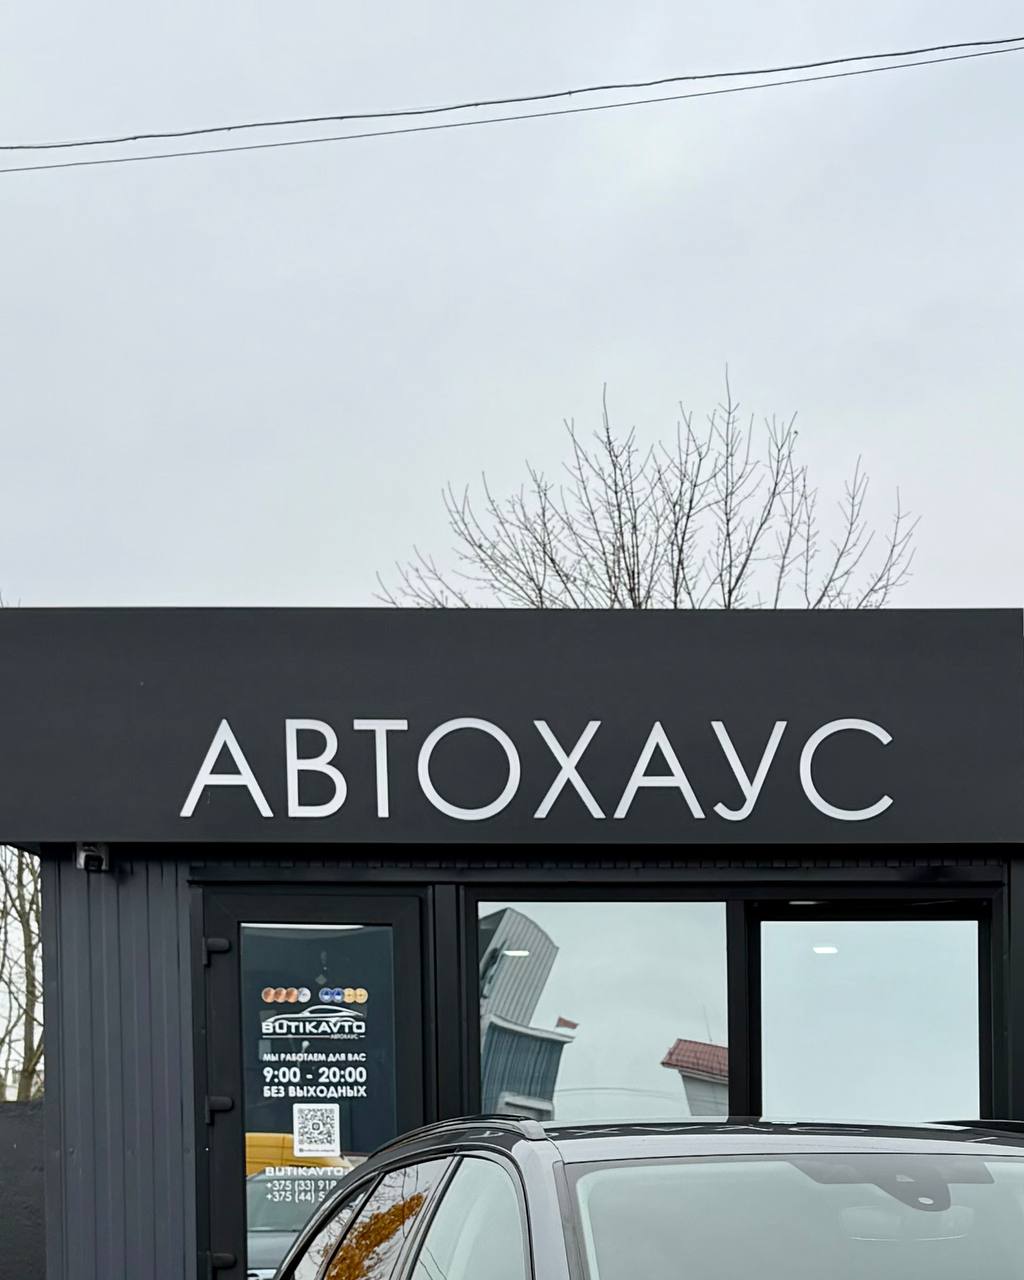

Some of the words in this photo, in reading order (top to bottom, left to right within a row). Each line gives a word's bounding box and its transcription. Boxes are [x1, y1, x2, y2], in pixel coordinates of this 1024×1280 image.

[179, 717, 895, 821] АВТОХАУС
[261, 1021, 366, 1034] BUTIKAVTO
[262, 1053, 279, 1062] МЫ
[280, 1053, 326, 1062] РАБОТАЕМ
[327, 1053, 346, 1062] ДЛЯ
[347, 1053, 367, 1062] ВАС
[262, 1066, 301, 1083] 9:00
[318, 1066, 367, 1083] 20:00
[263, 1086, 285, 1098] БЕЗ
[288, 1085, 367, 1098] ВЫХОДНЫХ
[265, 1167, 348, 1176] BUTIKAVTO.
[266, 1180, 292, 1190] +375
[295, 1180, 315, 1192] (33)
[266, 1192, 292, 1202] +375
[295, 1191, 315, 1203] (44)
